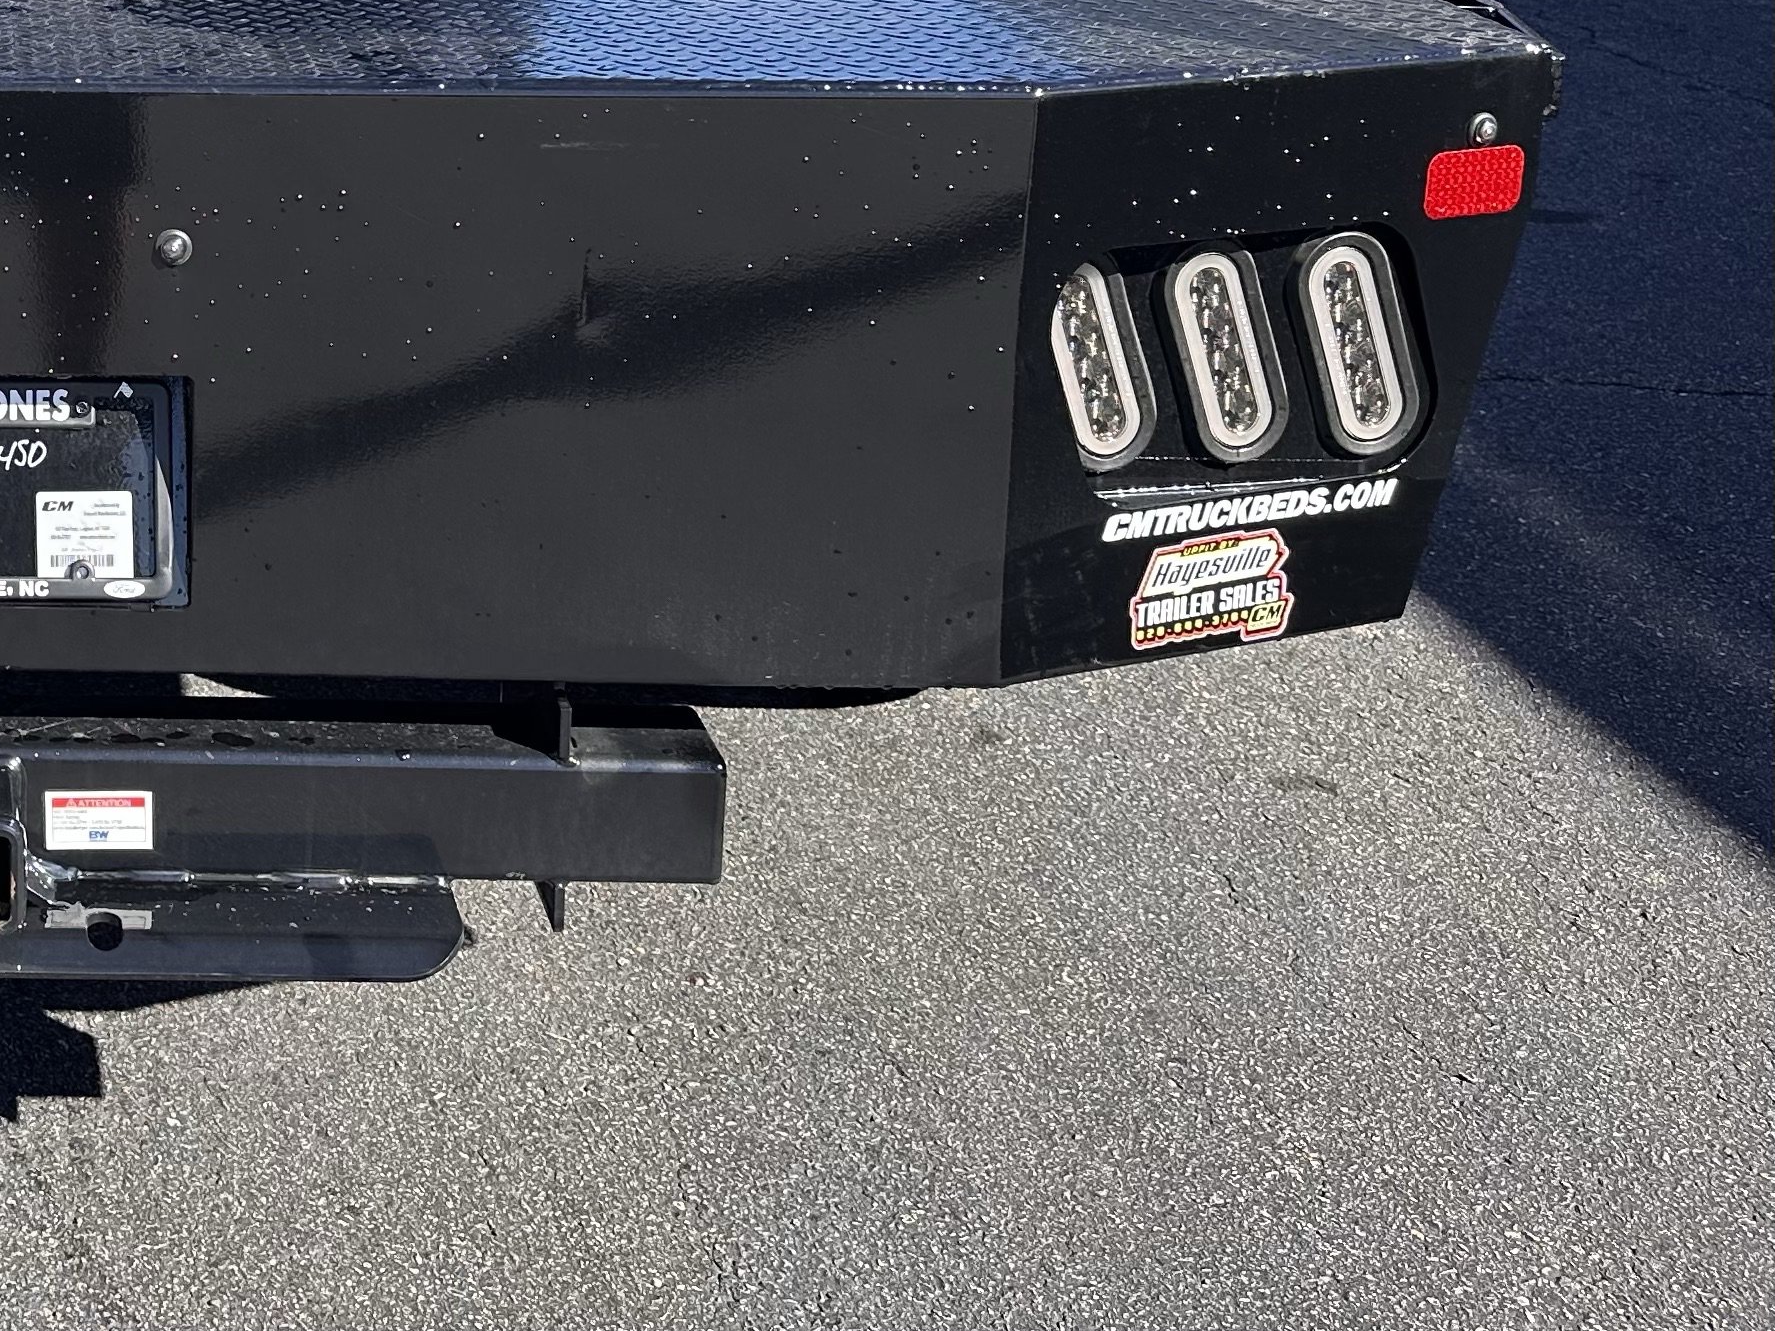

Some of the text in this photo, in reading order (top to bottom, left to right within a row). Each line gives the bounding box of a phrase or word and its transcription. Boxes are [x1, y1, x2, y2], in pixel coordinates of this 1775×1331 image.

[42, 500, 74, 512] CM
[1101, 477, 1399, 543] CMTRUCKBEDS.COM
[1151, 545, 1272, 588] Hayesville
[18, 579, 50, 598] NC
[1135, 577, 1281, 628] TRAILER SALES
[1252, 604, 1282, 622] CM
